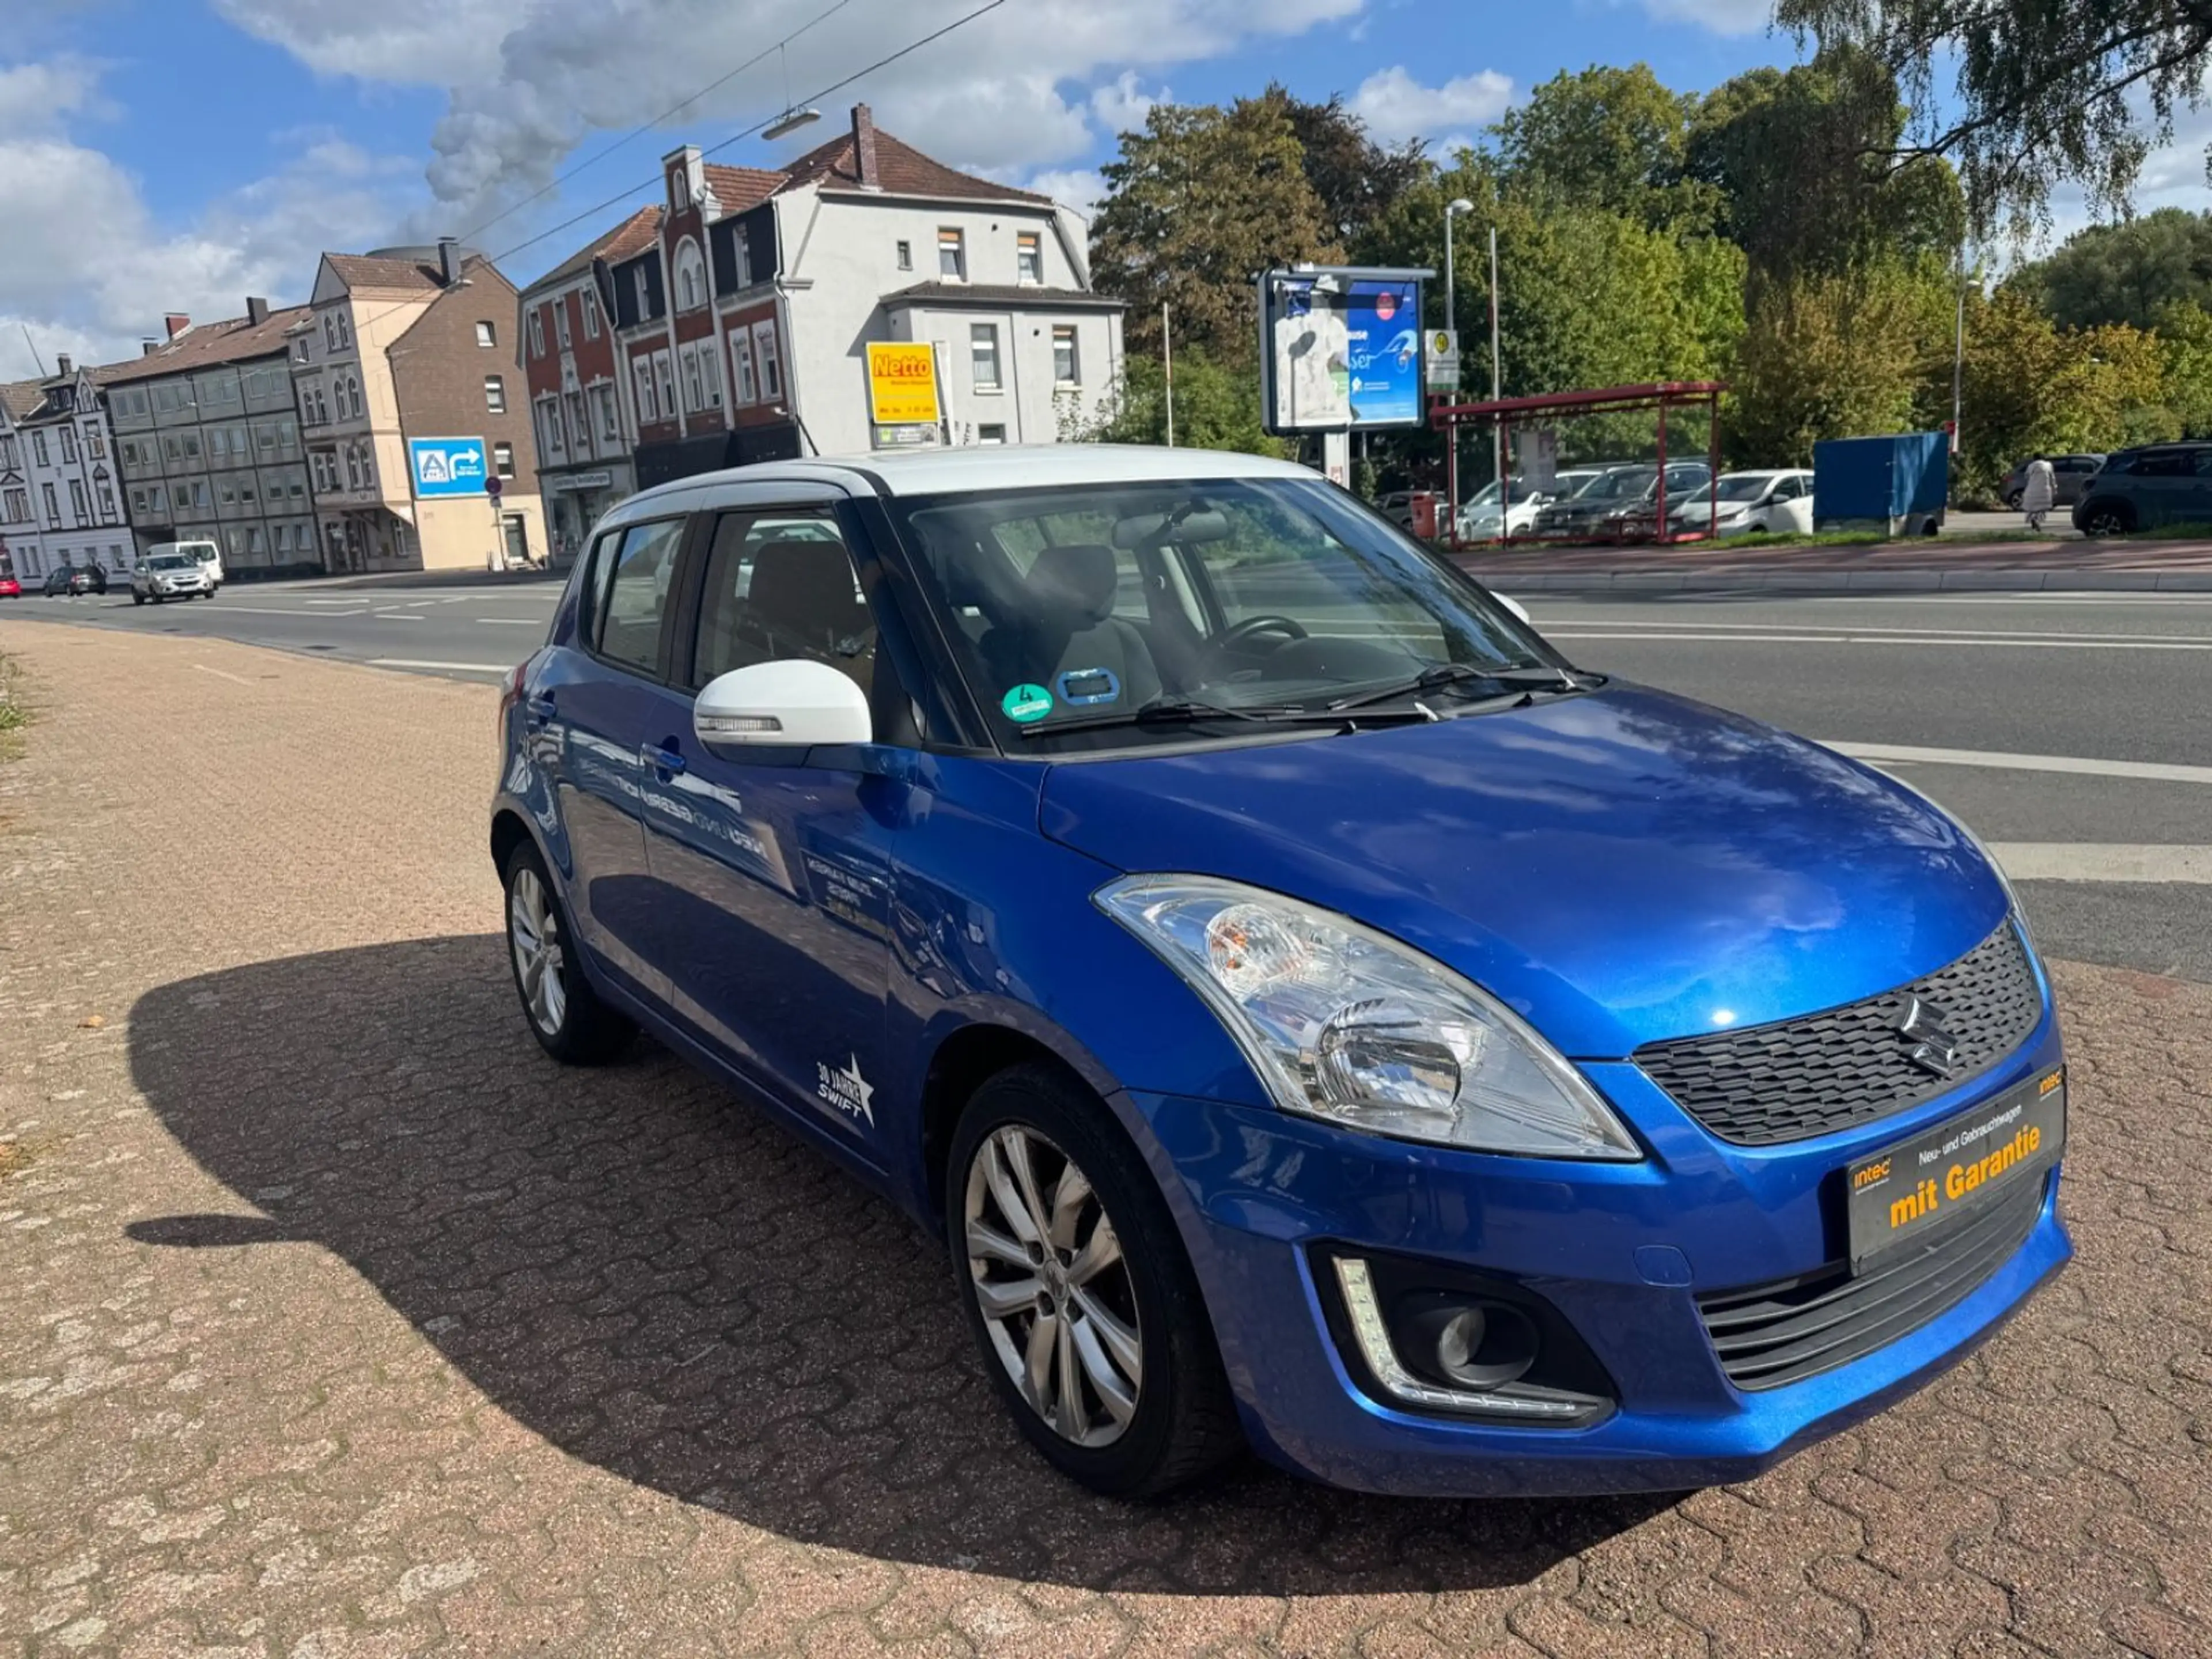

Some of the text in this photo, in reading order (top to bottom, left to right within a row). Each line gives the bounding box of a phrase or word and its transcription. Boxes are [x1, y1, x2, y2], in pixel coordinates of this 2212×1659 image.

[874, 354, 930, 377] Netto
[1019, 685, 1033, 702] 4
[818, 1083, 862, 1118] SWIFT
[1919, 1149, 1941, 1166] Neu-
[1942, 1134, 1959, 1156] und
[1891, 1124, 2040, 1228] mit Garantie
